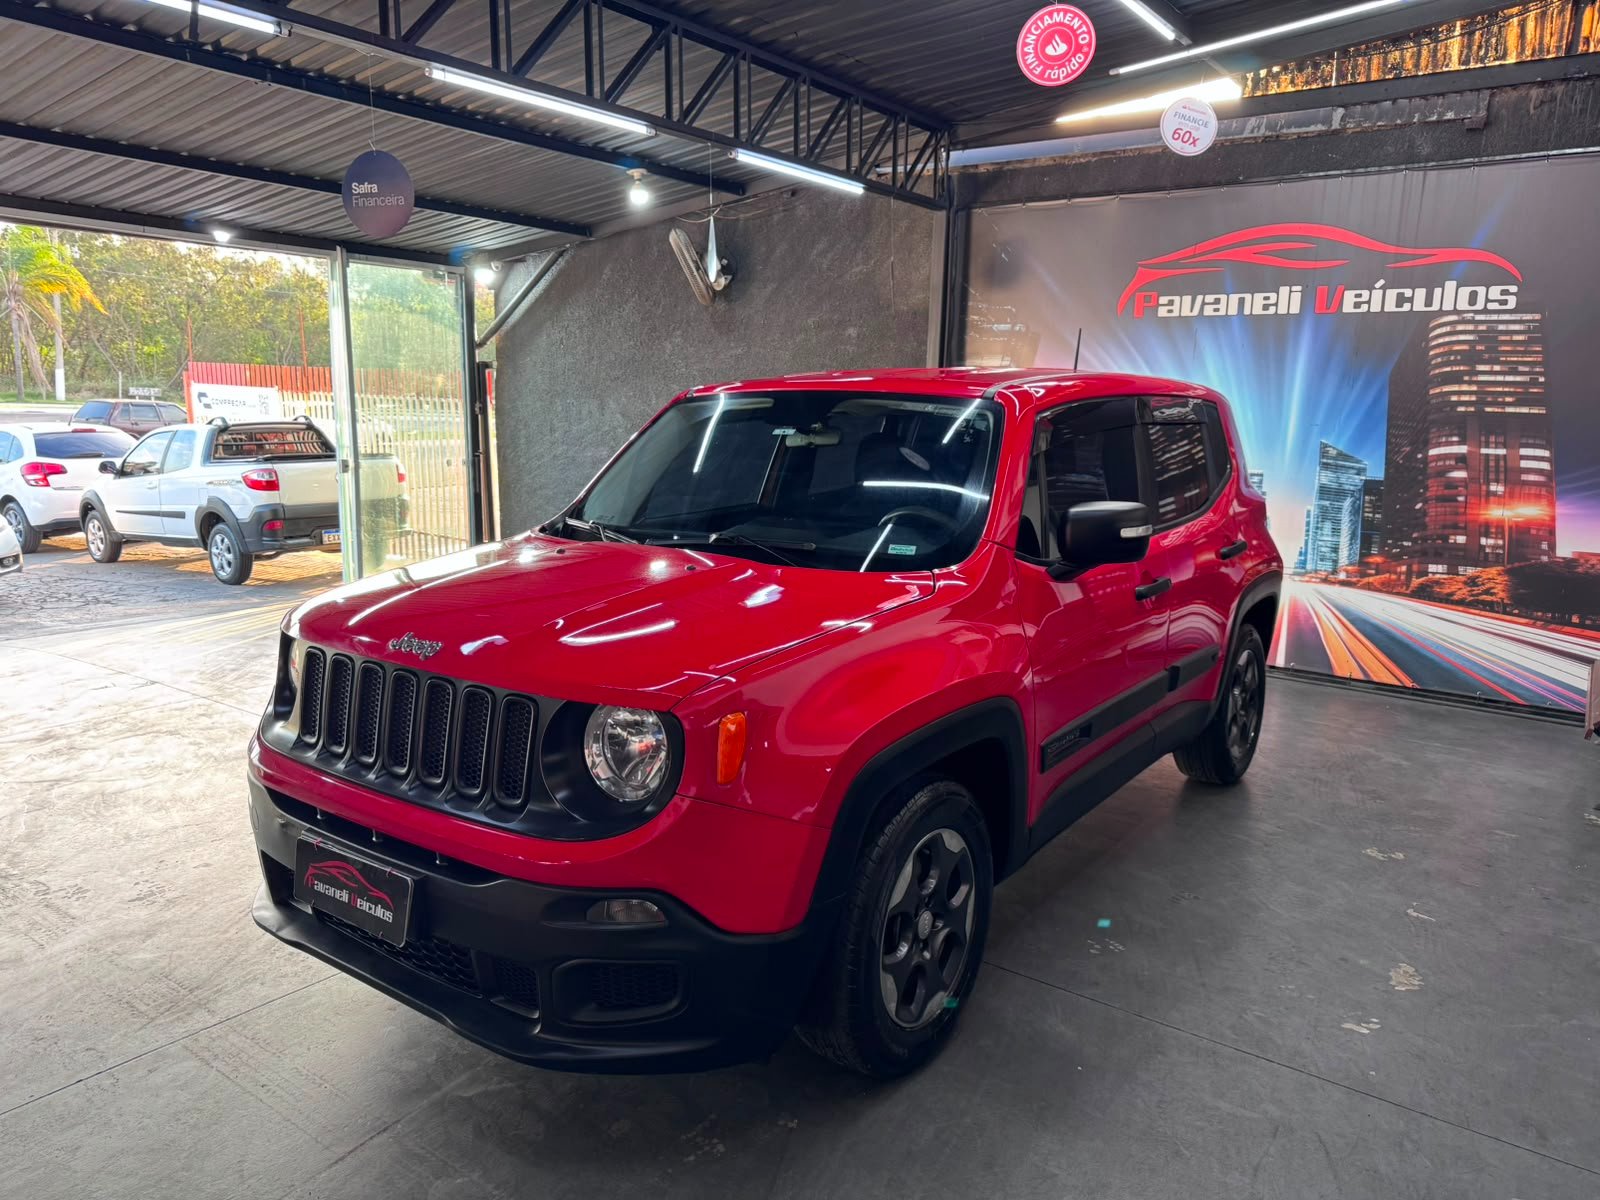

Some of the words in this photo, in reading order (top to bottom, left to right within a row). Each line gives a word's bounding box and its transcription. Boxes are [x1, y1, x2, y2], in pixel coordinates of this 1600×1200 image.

[1024, 11, 1090, 75] FINANCIAMENTO
[1044, 54, 1085, 80] rápido
[1173, 111, 1210, 128] FINANCIE
[1171, 127, 1200, 147] 60x
[351, 182, 378, 194] Safra
[352, 194, 405, 208] Financeira
[1133, 285, 1302, 318] Pavaneli
[1314, 278, 1518, 314] Veículos
[386, 631, 443, 661] Jeep
[308, 875, 350, 903] Pavaneli
[350, 892, 394, 923] Veículos
